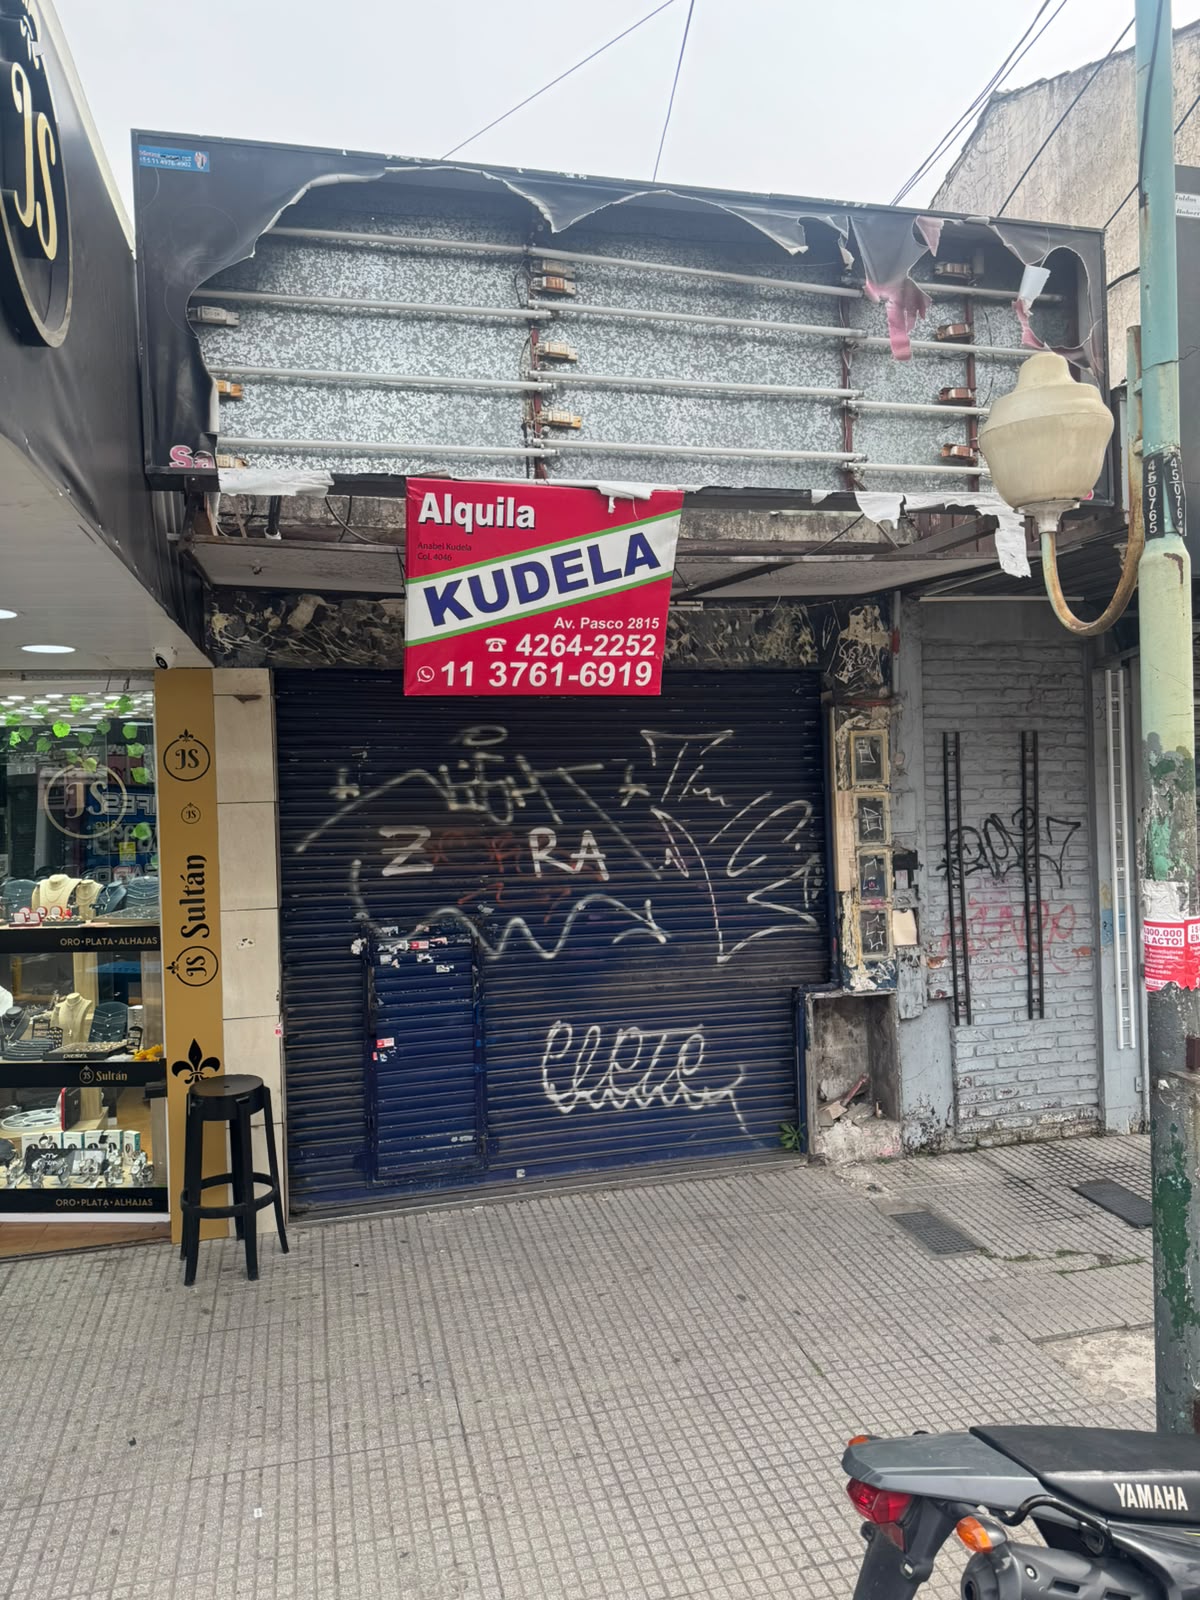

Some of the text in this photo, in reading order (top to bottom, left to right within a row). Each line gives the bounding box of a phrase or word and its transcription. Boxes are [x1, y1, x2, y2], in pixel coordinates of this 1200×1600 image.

[418, 492, 536, 534] Alquila
[417, 541, 472, 552] Anabel Kudela
[433, 553, 452, 562] 4046
[423, 532, 661, 627] KUDELA
[554, 617, 660, 630] Av. Pasco 2815
[516, 633, 657, 657] 4264-2252
[441, 661, 653, 688] 11 3761-6919
[175, 748, 200, 770] JS
[185, 809, 197, 820] JS
[179, 854, 210, 939] Sultán
[60, 936, 158, 946] ORO PLATA ALHAJAS
[1152, 937, 1183, 946] ACTO!
[186, 955, 207, 977] JS
[96, 1070, 128, 1081] Sultán
[55, 1198, 153, 1207] ORO PLATA ALHAJAS
[1114, 1482, 1189, 1512] YAMAHA
